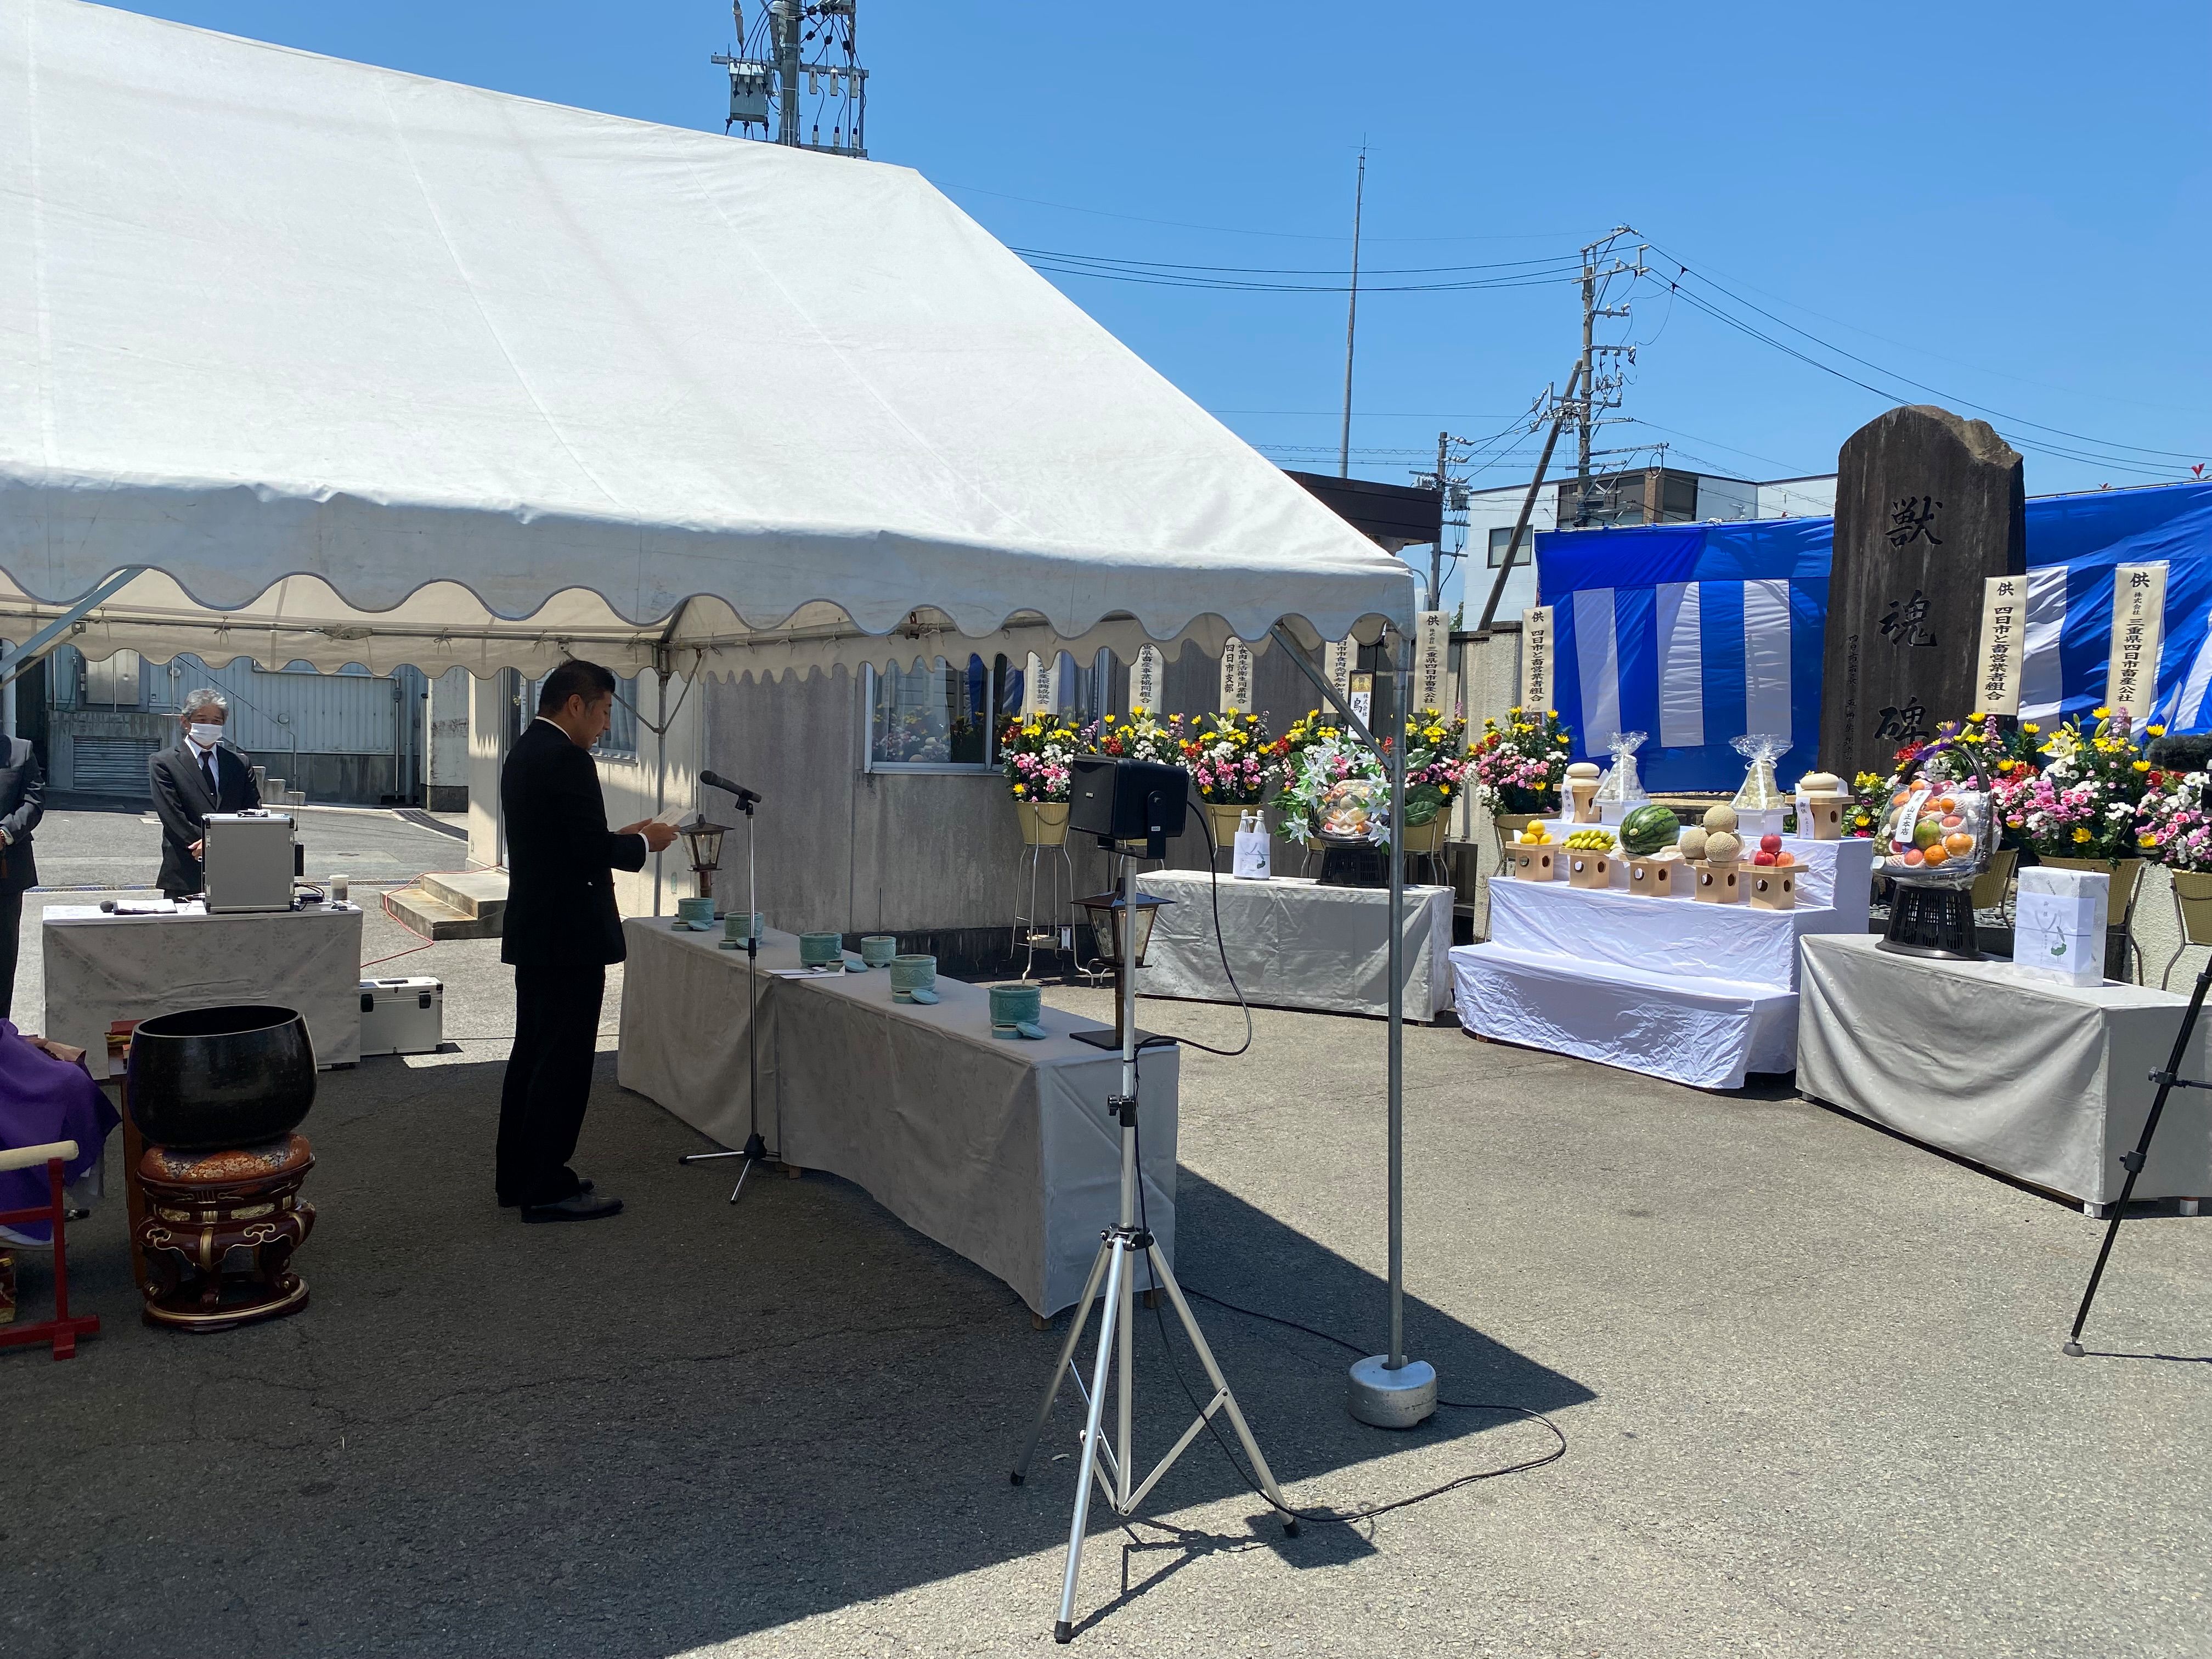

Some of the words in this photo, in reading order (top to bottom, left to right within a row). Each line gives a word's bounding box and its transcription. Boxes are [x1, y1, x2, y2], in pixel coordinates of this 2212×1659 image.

[1997, 582, 2015, 596] 供
[2130, 572, 2151, 588] 供
[2132, 591, 2143, 616] 株式会社
[1426, 615, 1440, 626] 供
[1531, 611, 1545, 623] 供
[1874, 496, 1943, 742] 獣魂碑
[1224, 644, 1235, 693] 四日市支部
[1423, 646, 1438, 703] 三重県四日市畜産公社
[1528, 630, 1545, 702] 四日市と畜営業者組合
[1985, 606, 2014, 701] 四日市と畜営業者組合
[2117, 618, 2145, 702] 三重県四日市畜産公社
